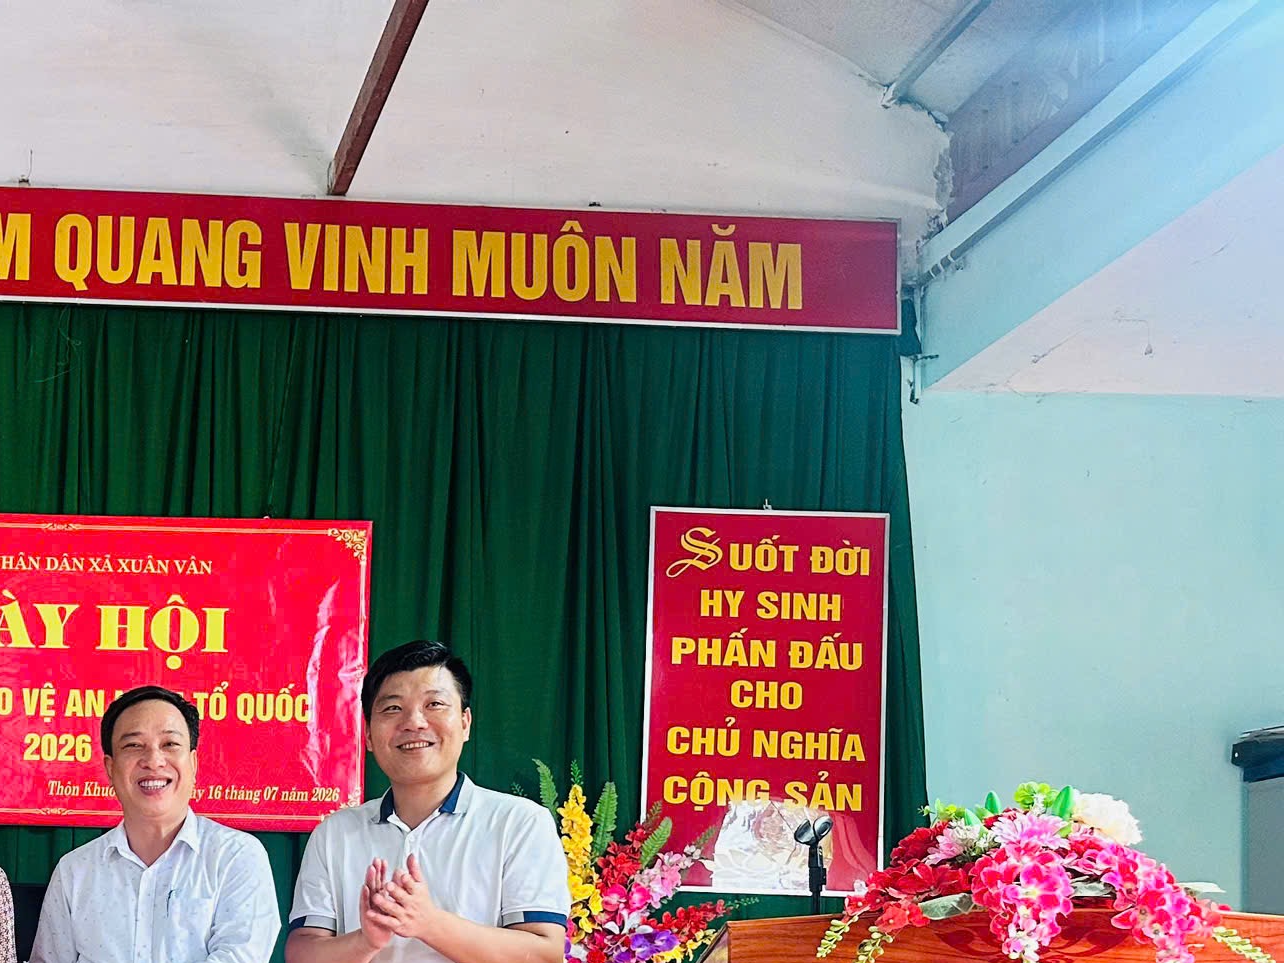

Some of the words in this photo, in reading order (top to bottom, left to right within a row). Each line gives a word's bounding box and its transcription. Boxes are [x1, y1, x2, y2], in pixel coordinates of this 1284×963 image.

[53, 212, 264, 291] QUANG
[283, 221, 431, 296] VINH
[451, 220, 638, 306] MUÔN
[659, 223, 805, 311] NĂM
[45, 553, 85, 573] DÂN
[90, 553, 114, 574] XÃ
[117, 555, 170, 575] XUÂN
[175, 556, 213, 576] VÂN
[665, 526, 799, 578] SUỐT
[809, 539, 871, 577] ĐỜI
[700, 589, 745, 618] HY
[756, 591, 841, 622] SINH
[96, 594, 228, 670] HỘI
[671, 628, 776, 668] PHẤN
[788, 632, 863, 671] ĐẤU
[22, 682, 55, 722] VỆ
[65, 689, 104, 717] AN
[193, 682, 228, 721] TỔ
[236, 683, 313, 725] QUỐC
[730, 681, 804, 710] CHO
[23, 732, 92, 763] 2026
[666, 716, 741, 757] CHỦ
[752, 728, 866, 762] NGHĨA
[48, 780, 79, 796] Thôn
[208, 785, 222, 800] 16
[225, 785, 262, 804] tháng
[263, 786, 278, 801] 07
[282, 788, 308, 801] năm
[312, 788, 340, 802] 2026
[663, 771, 770, 812] CỘNG
[784, 771, 862, 811] SẢN
